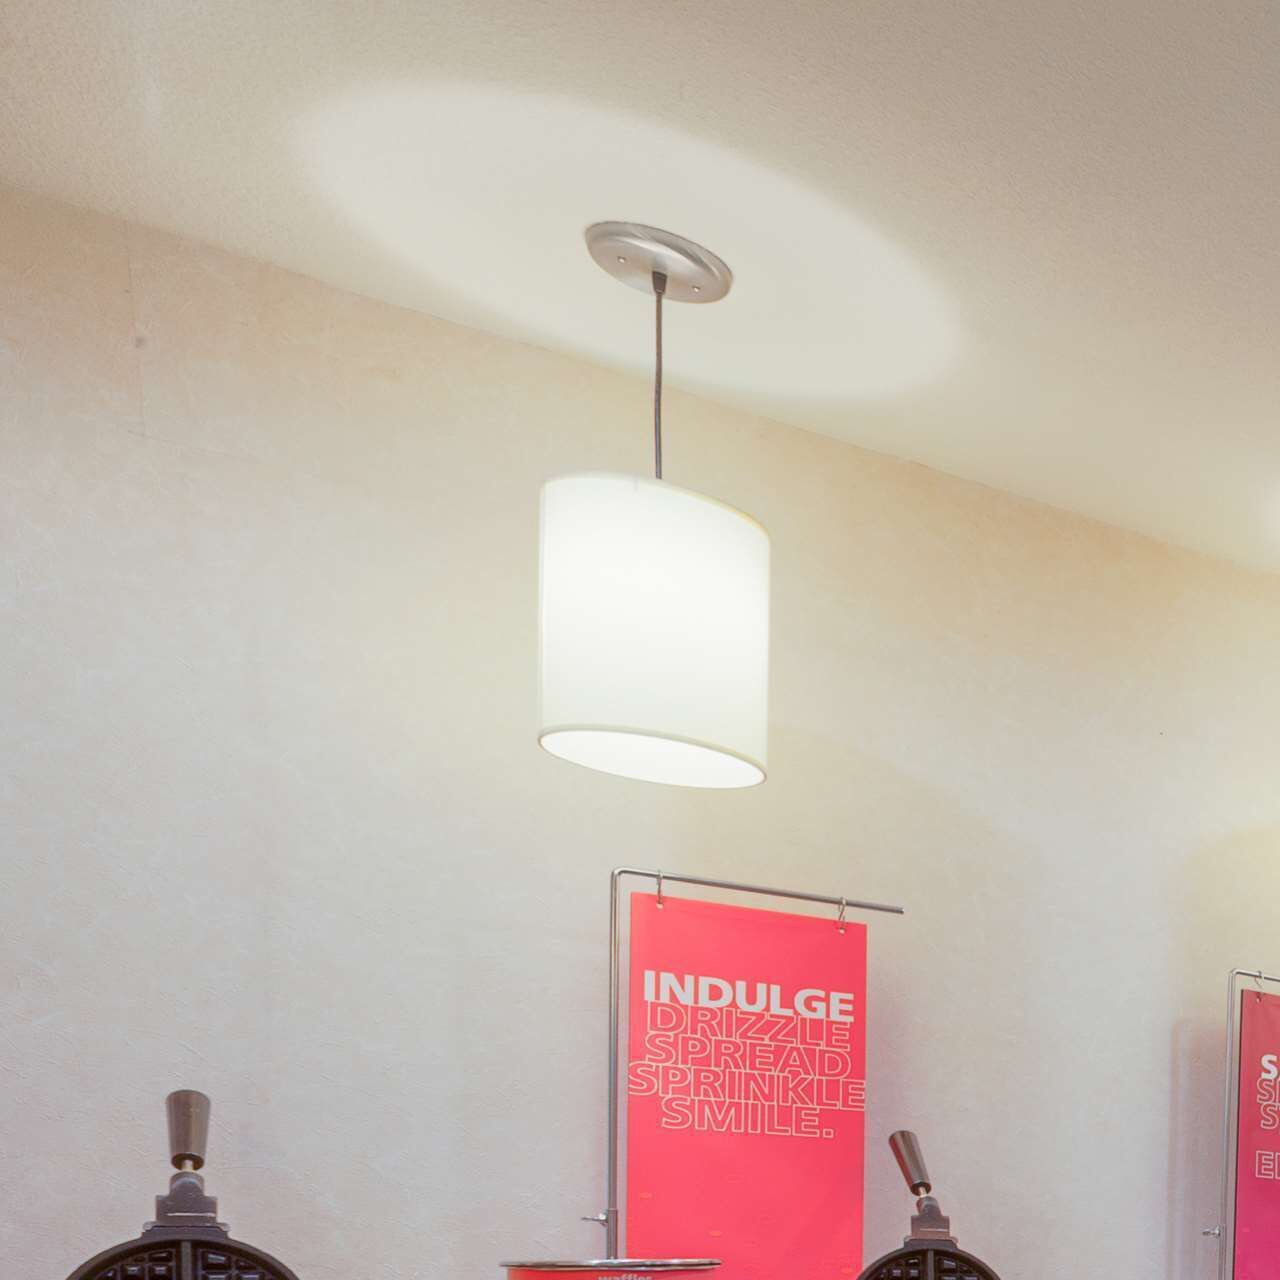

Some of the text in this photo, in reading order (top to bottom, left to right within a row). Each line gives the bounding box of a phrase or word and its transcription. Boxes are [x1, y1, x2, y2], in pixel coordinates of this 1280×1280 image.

[643, 969, 855, 1023] INDULGE
[646, 1000, 851, 1051] DRIZZLE
[643, 1031, 852, 1081] SPREAD
[628, 1059, 866, 1112] SPRINKLE
[660, 1093, 834, 1139] SMILE.
